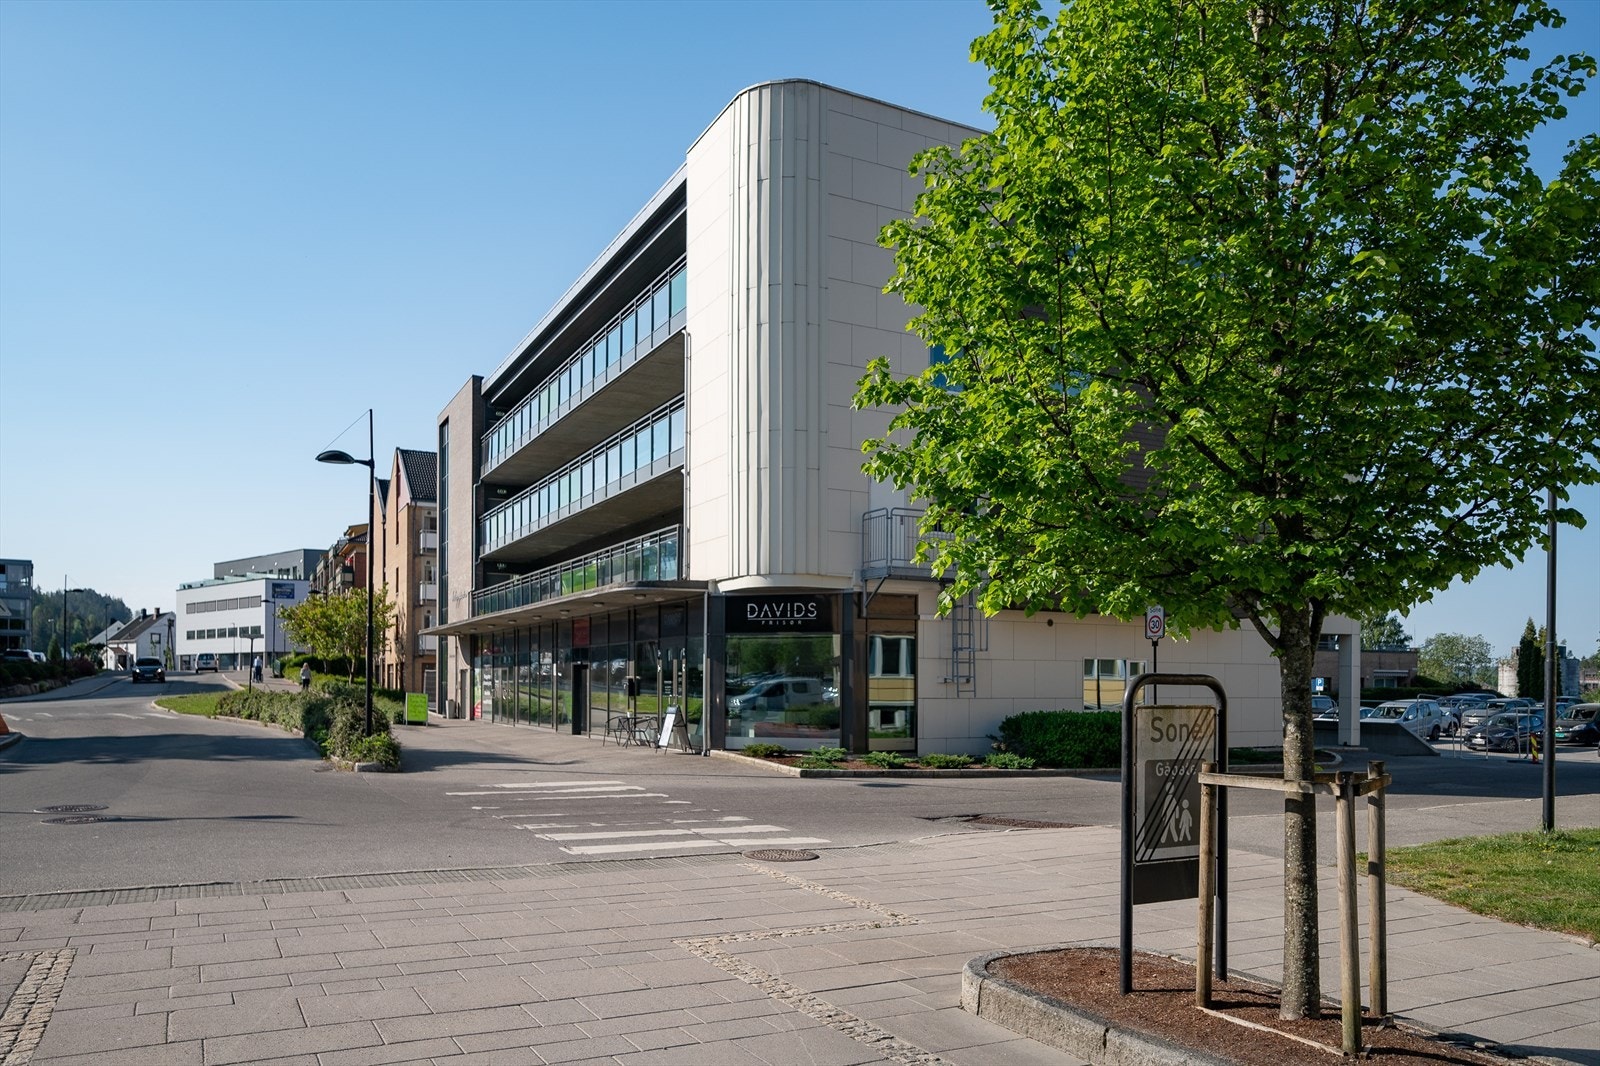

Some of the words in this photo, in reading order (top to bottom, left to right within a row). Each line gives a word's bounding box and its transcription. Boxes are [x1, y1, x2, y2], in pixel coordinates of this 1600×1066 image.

[747, 602, 817, 618] DAVIDS
[1151, 620, 1160, 629] 30
[1150, 716, 1203, 742] Sone
